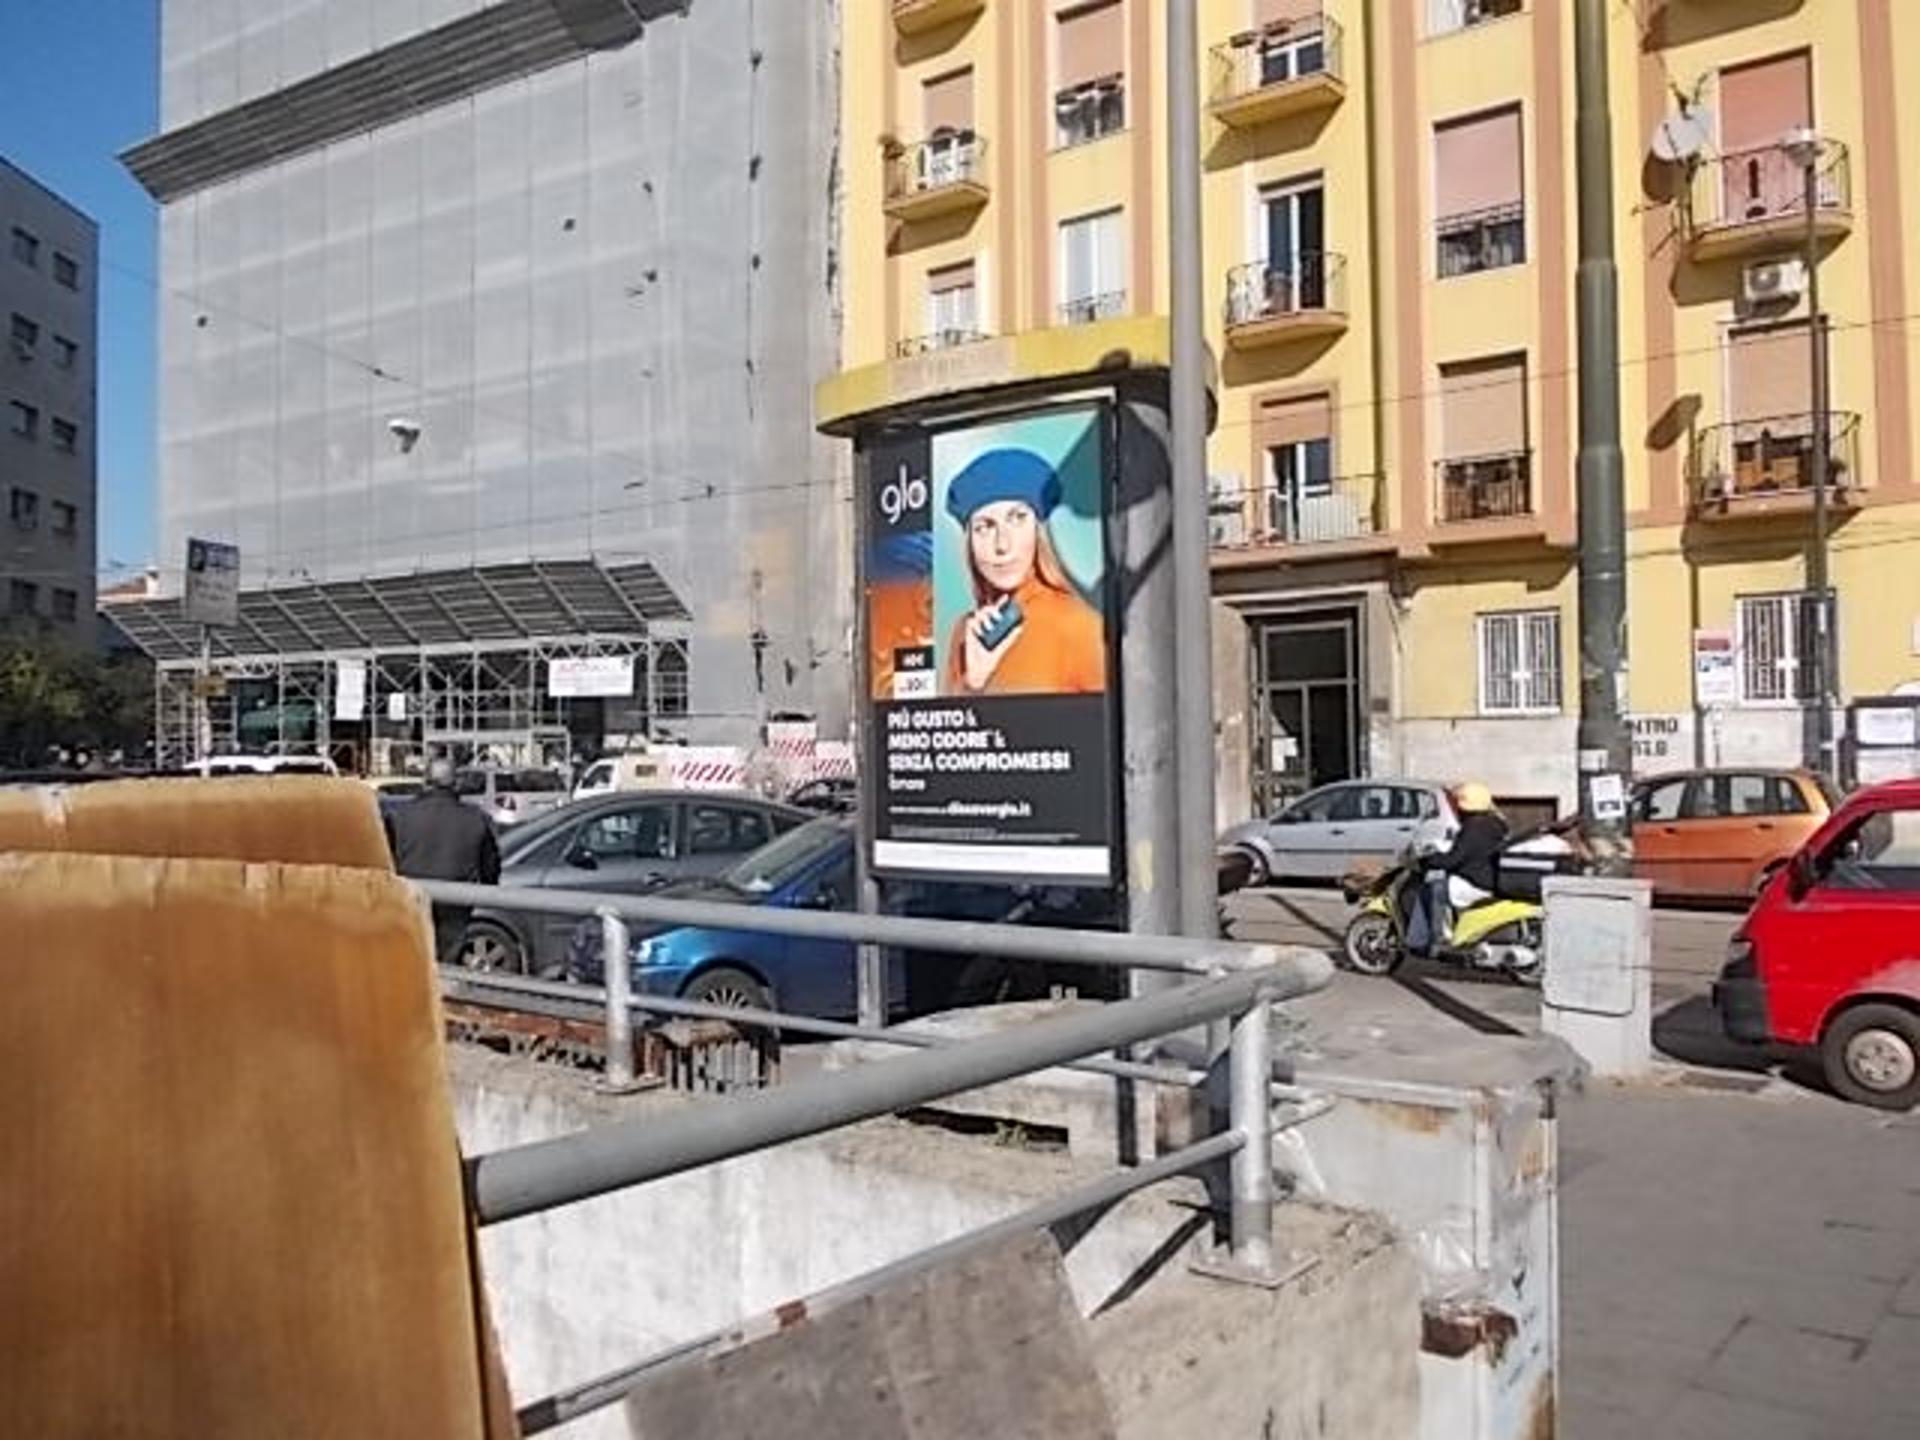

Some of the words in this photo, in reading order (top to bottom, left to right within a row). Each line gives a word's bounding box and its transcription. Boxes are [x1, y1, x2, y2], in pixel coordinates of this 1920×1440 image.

[881, 464, 927, 524] glo
[912, 709, 964, 729] GUSTO
[936, 751, 1071, 771] COMPROMESSI
